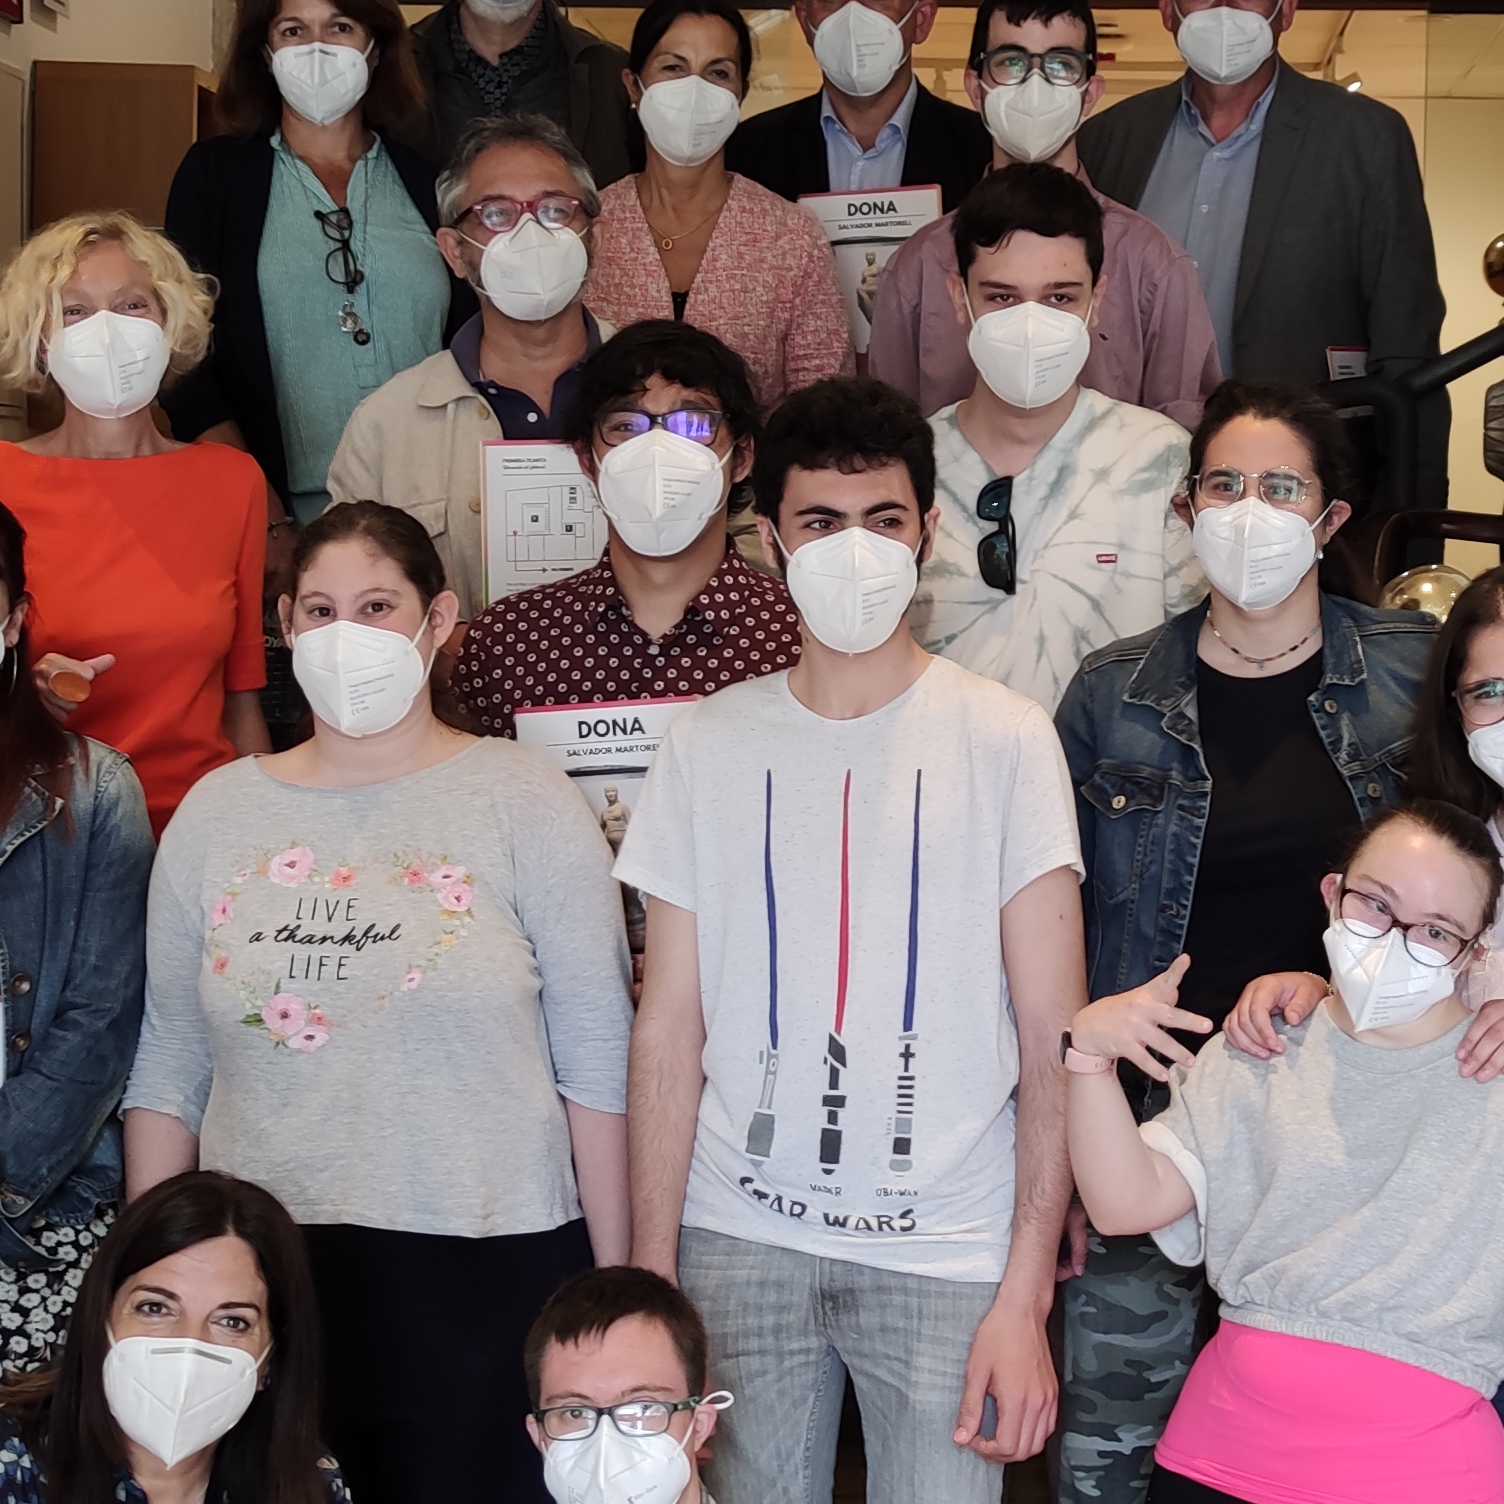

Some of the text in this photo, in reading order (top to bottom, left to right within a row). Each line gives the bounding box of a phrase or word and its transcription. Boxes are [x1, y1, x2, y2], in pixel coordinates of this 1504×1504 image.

[848, 200, 898, 216] DONA
[838, 222, 873, 230] SALVADOR
[577, 716, 646, 739] DONA
[567, 747, 613, 757] SALVADOR
[296, 897, 359, 921] LIVE
[249, 923, 401, 951] a thankful
[288, 953, 351, 981] LIFE
[822, 1208, 917, 1232] WARS
